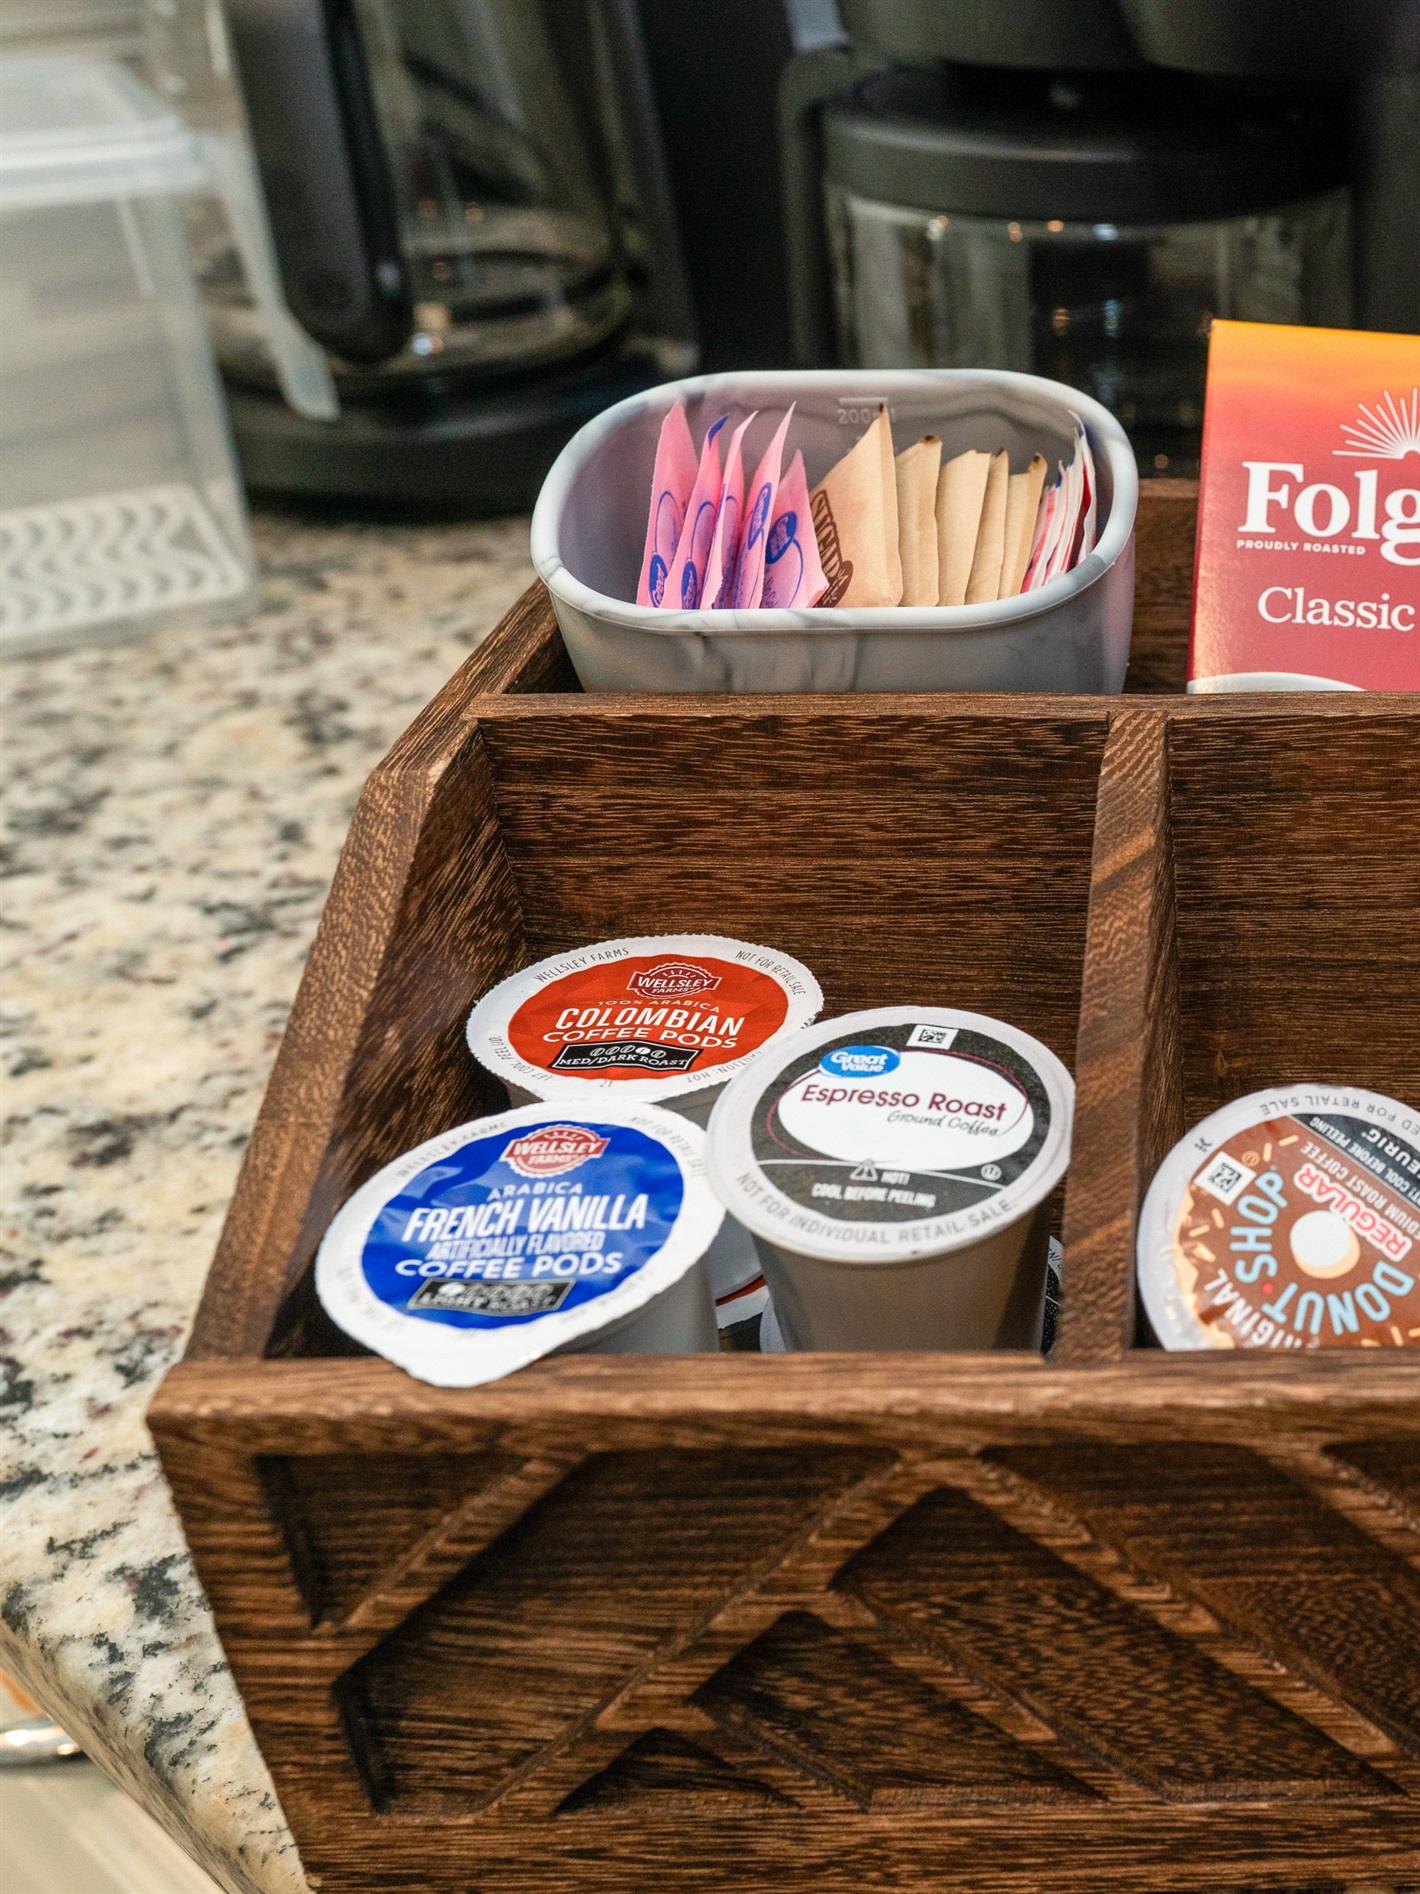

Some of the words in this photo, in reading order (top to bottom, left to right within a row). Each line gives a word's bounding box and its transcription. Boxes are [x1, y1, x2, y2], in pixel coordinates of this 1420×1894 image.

[1236, 539, 1299, 551] PROUDLY
[1303, 542, 1366, 555] ROASTED
[1257, 586, 1416, 632] Classic
[533, 957, 587, 982] WELLSLEY
[590, 947, 630, 962] FARMS
[735, 950, 758, 962] NOT
[754, 956, 775, 969] FOR
[638, 976, 713, 988] WELLSLEY
[648, 999, 720, 1013] ARABICA
[555, 1007, 745, 1037] COLOMBIAN
[542, 1026, 654, 1043] COFFEE
[658, 1029, 739, 1049] PODS
[559, 1053, 639, 1067] MED/DARK
[640, 1054, 689, 1067] ROAST
[830, 1050, 889, 1068] Great
[841, 1060, 884, 1073] Value
[801, 1084, 920, 1108] Espresso
[928, 1092, 1007, 1121] Roast
[1259, 1097, 1300, 1115] SALE
[1306, 1095, 1361, 1109] RETAIL
[1366, 1103, 1397, 1123] FOR
[887, 1110, 943, 1127] Ground
[1309, 1117, 1351, 1148] PEELING
[513, 1140, 602, 1156] WELLSLEY
[1300, 1141, 1349, 1180] COFFEE
[1347, 1142, 1387, 1174] BEFORE
[486, 1181, 583, 1202] ARABICA
[1346, 1175, 1388, 1209] ROAST
[1384, 1168, 1411, 1193] COOL
[402, 1199, 525, 1242] FRENCH
[527, 1193, 649, 1233] VANILLA
[737, 1173, 765, 1204] NOT
[765, 1198, 788, 1220] FOR
[788, 1211, 891, 1245] INDIVIDUAL
[898, 1222, 965, 1243] RETAIL
[1296, 1165, 1409, 1258] REGULAR
[1230, 1171, 1288, 1284] SHOP
[395, 1256, 528, 1279] COFFEE
[531, 1251, 623, 1277] PODS
[1261, 1260, 1415, 1336] DONUT
